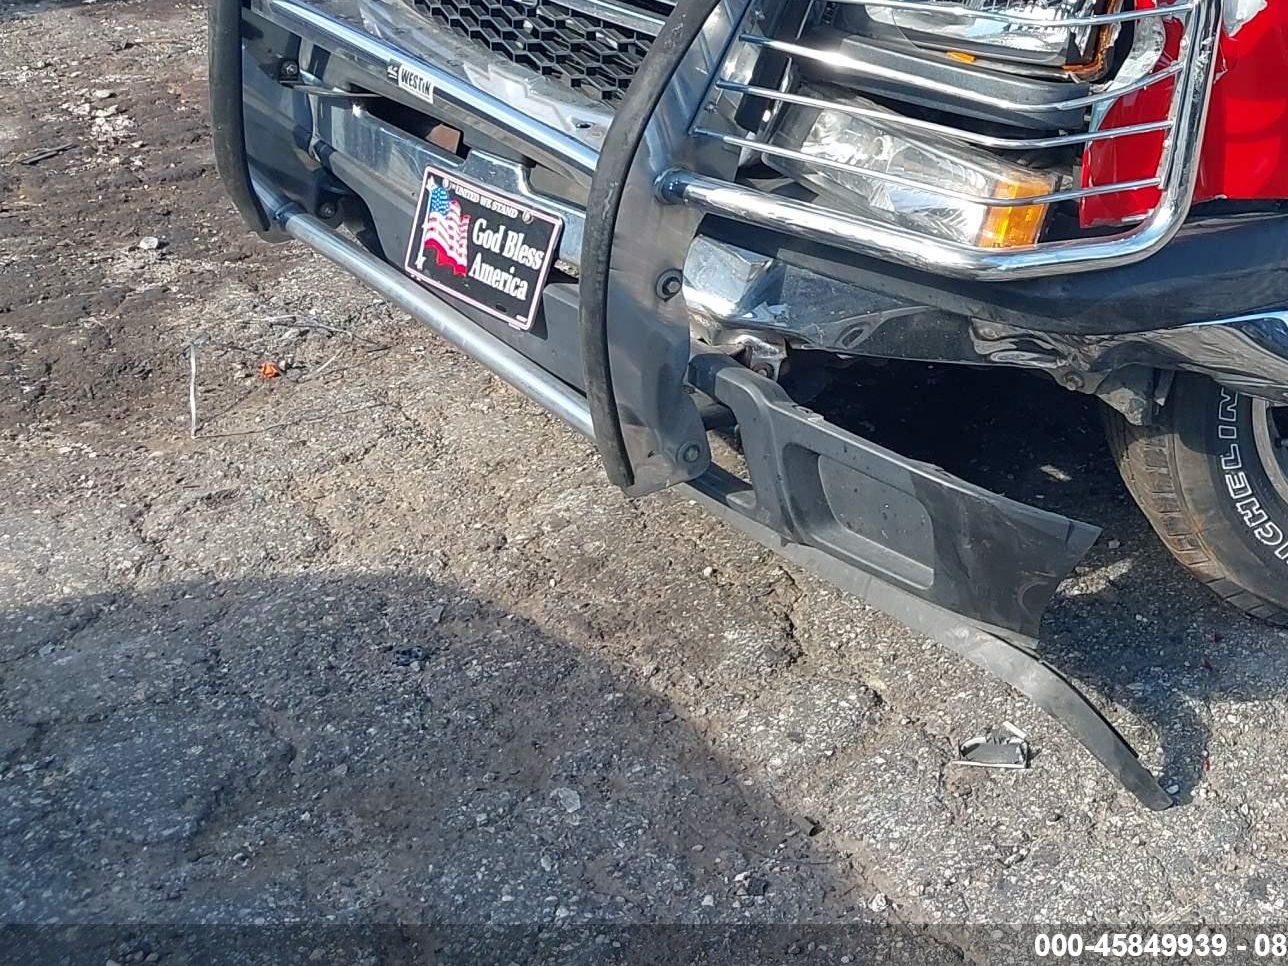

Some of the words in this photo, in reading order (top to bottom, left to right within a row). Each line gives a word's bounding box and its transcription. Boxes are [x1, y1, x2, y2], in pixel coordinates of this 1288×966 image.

[455, 183, 480, 203] UNITED
[480, 194, 492, 209] WE
[491, 200, 519, 219] STAND
[472, 217, 506, 253] God
[502, 229, 545, 270] Bless
[468, 251, 529, 301] America
